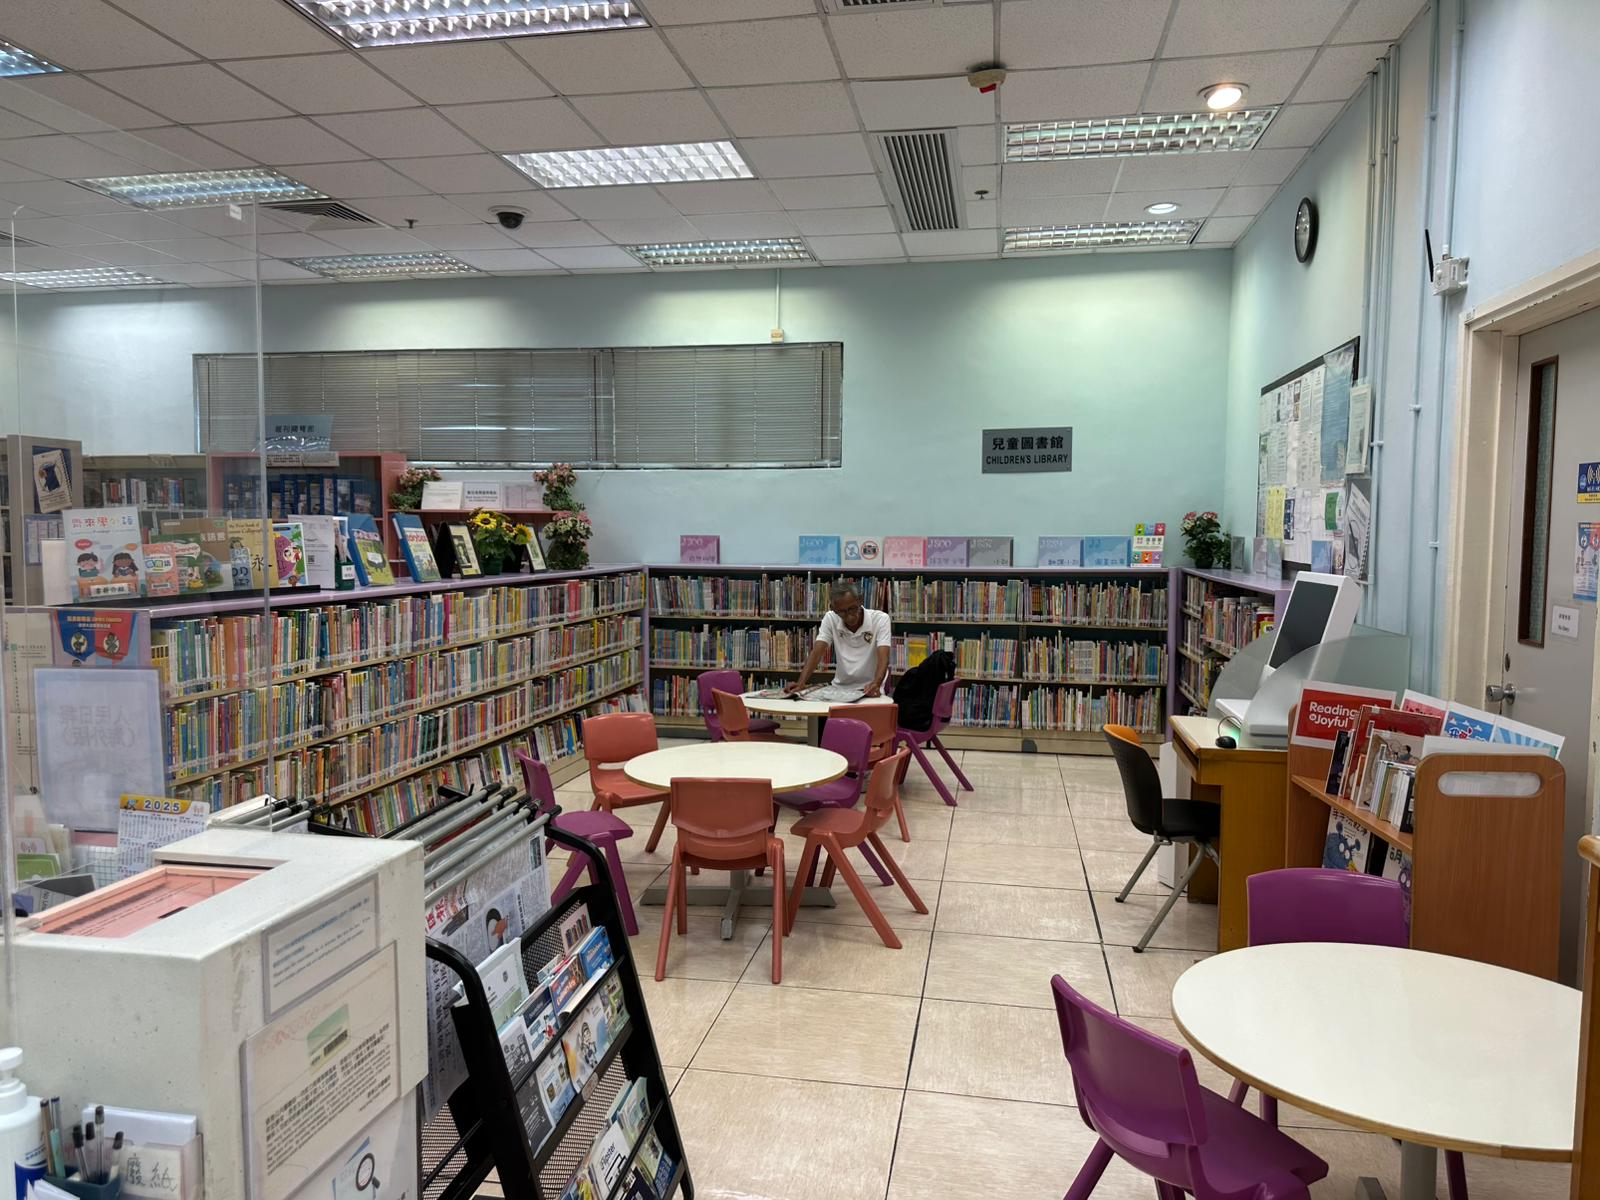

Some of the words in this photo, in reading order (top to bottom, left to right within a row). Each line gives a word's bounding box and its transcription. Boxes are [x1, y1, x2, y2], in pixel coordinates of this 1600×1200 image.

[992, 435, 1064, 450] 兒童圖書館
[985, 455, 1032, 465] CHILDREN'S
[1033, 454, 1068, 464] LIBRARY
[1310, 702, 1359, 719] Reading
[1314, 715, 1349, 728] Joyful
[145, 800, 180, 812] 2025
